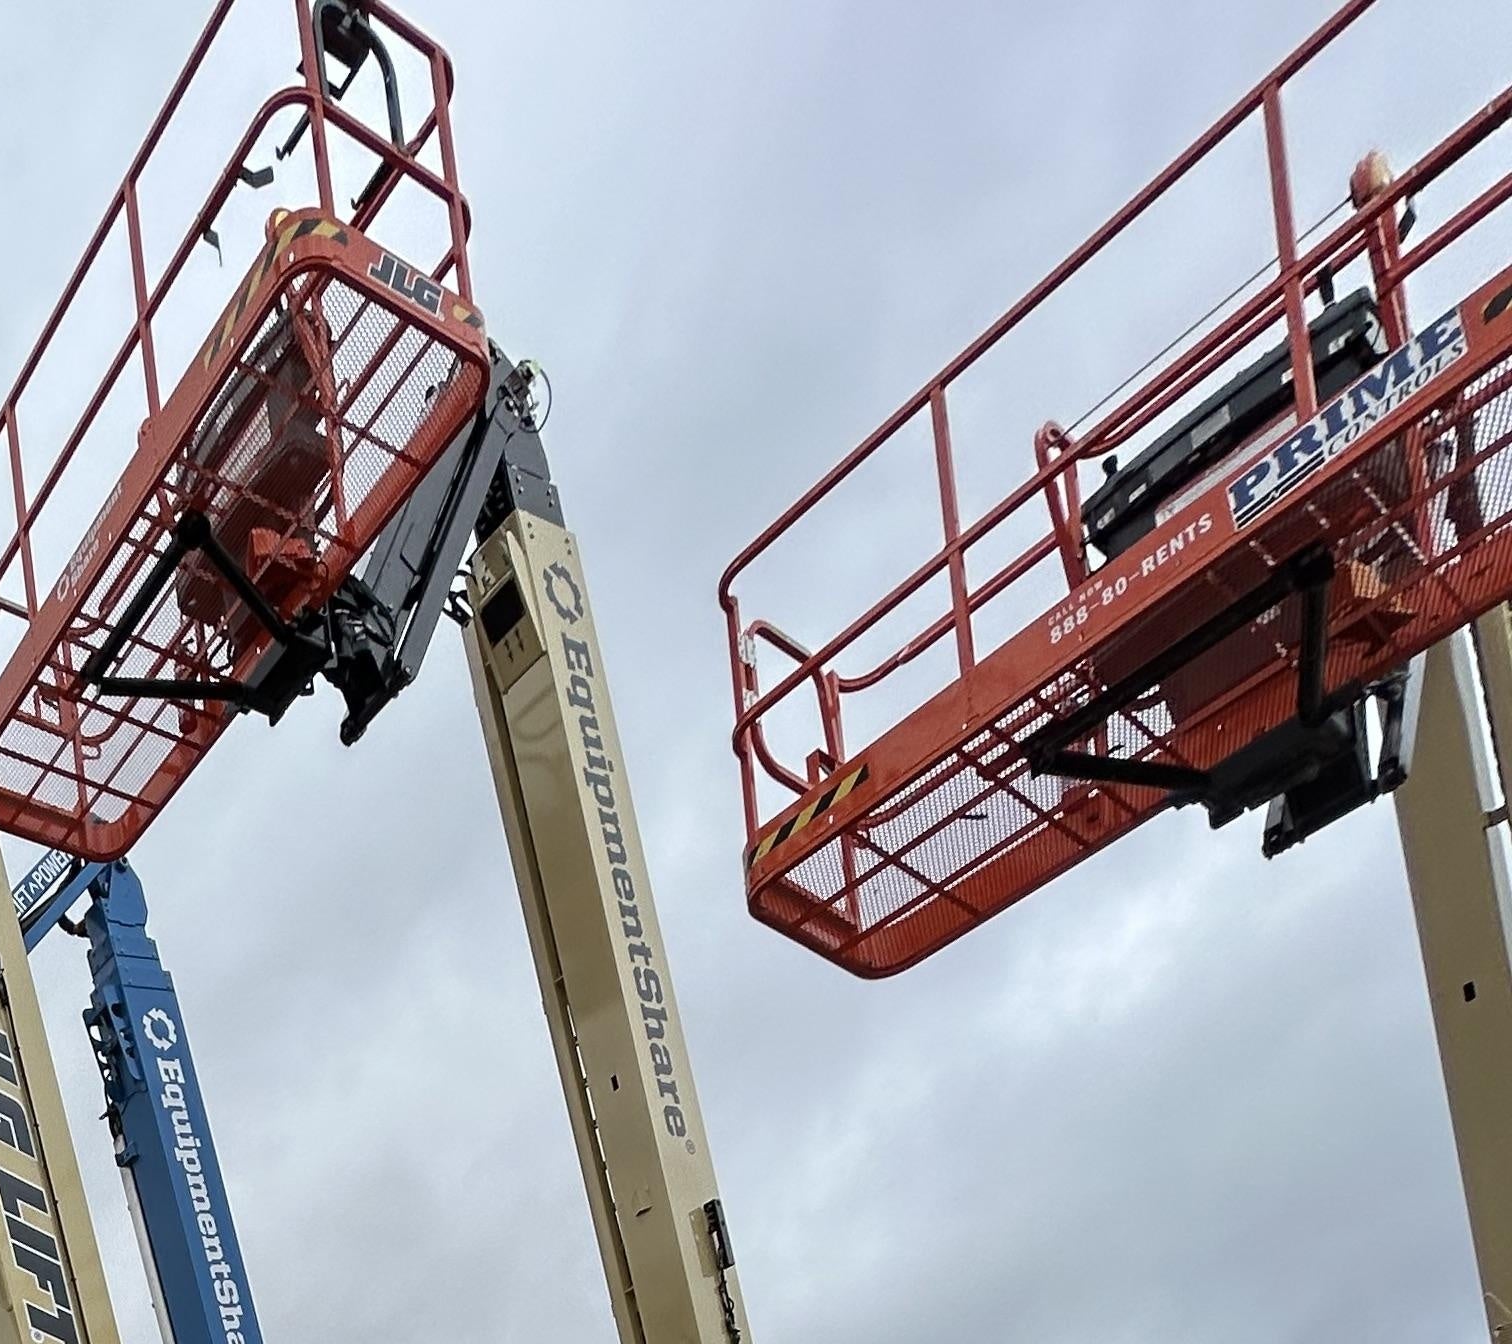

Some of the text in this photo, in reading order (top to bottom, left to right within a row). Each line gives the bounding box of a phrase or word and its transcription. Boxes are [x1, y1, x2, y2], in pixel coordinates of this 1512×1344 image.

[368, 252, 445, 317] JLG
[1229, 308, 1464, 509] PRIME
[1328, 342, 1465, 456] CONTROLS
[560, 631, 687, 1139] EquipmentShare
